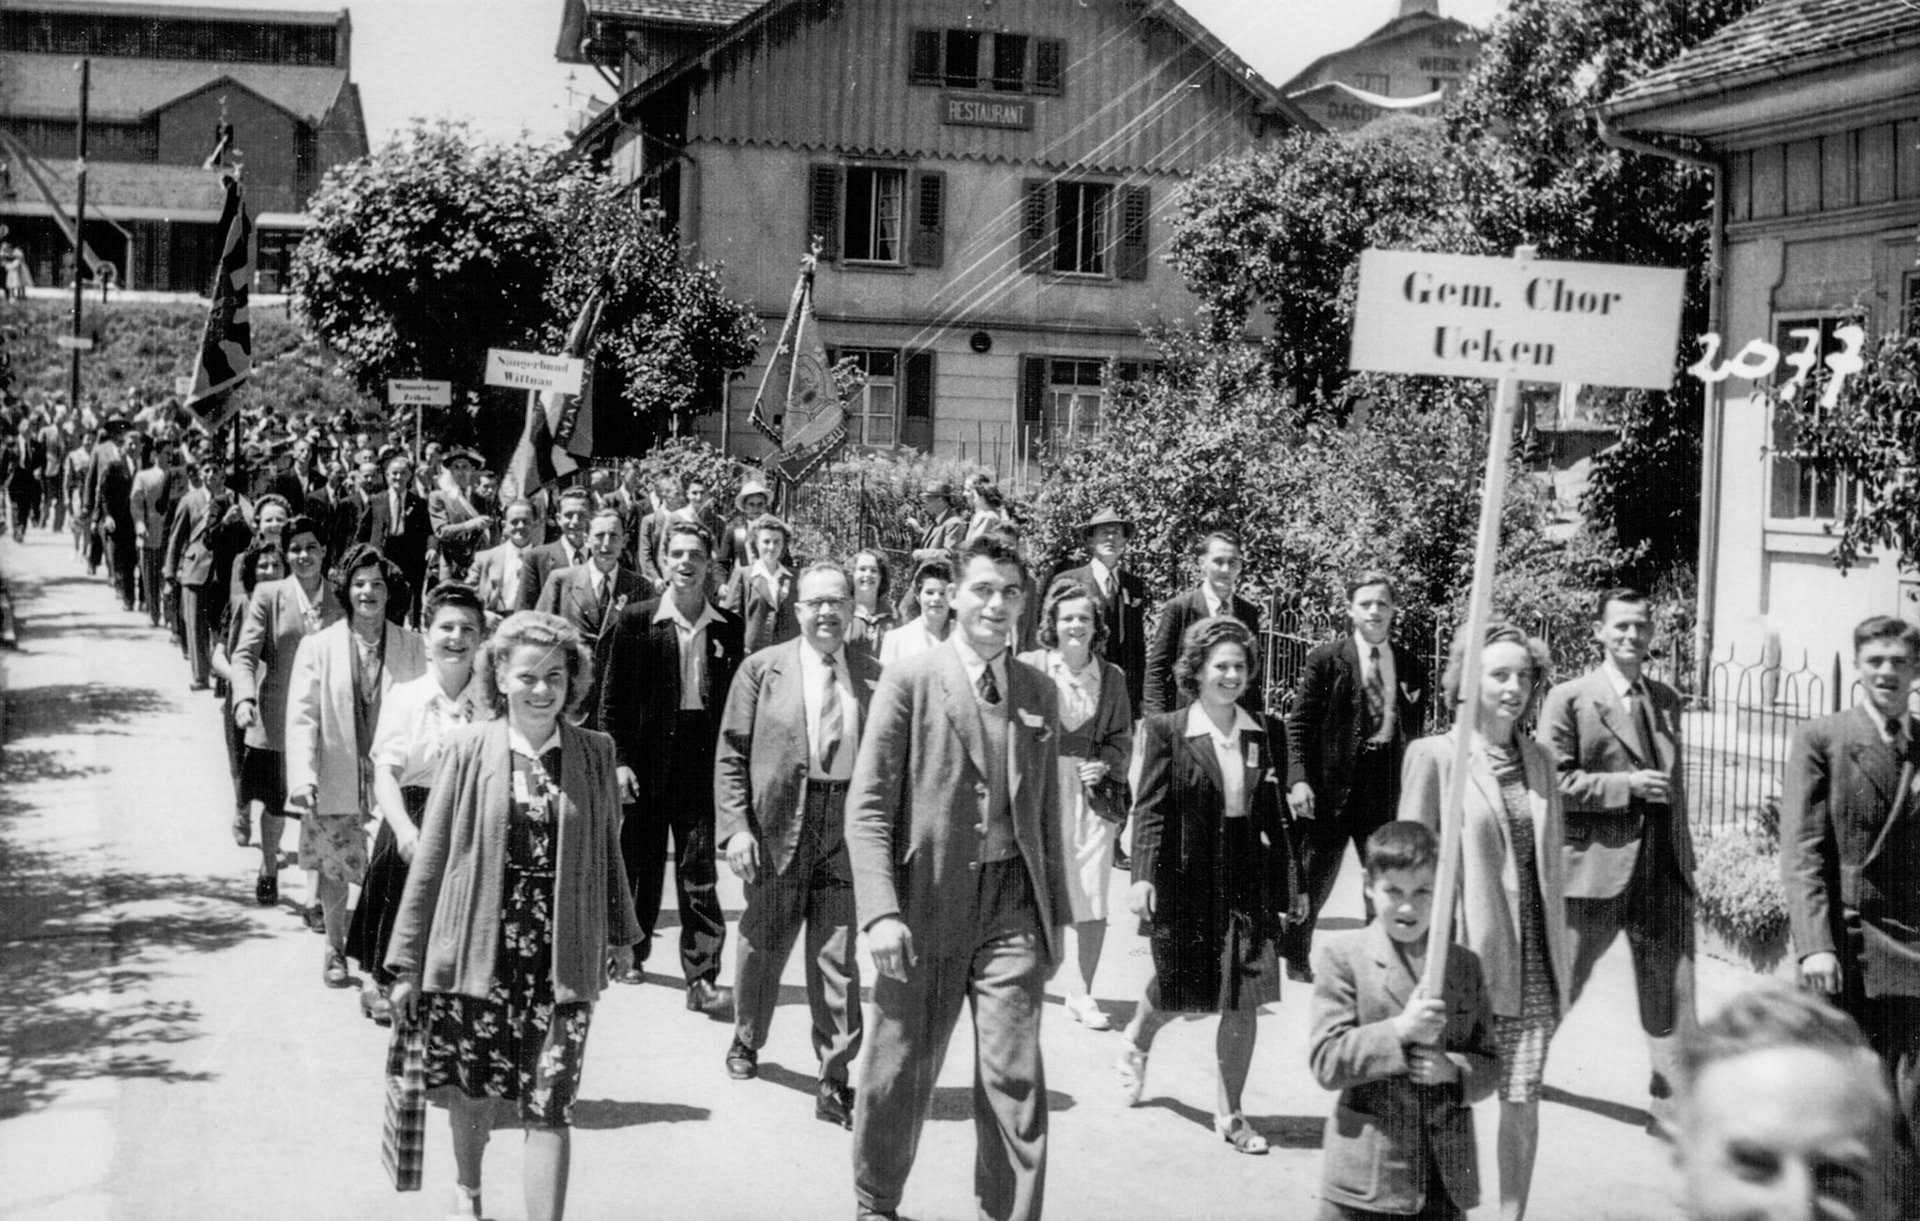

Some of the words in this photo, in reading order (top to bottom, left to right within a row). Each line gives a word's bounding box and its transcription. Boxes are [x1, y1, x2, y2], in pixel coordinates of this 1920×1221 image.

[949, 101, 1024, 124] RESTAURANT
[1403, 271, 1502, 309] Gem.
[1524, 277, 1622, 316] Chor
[1433, 326, 1556, 366] Ueken
